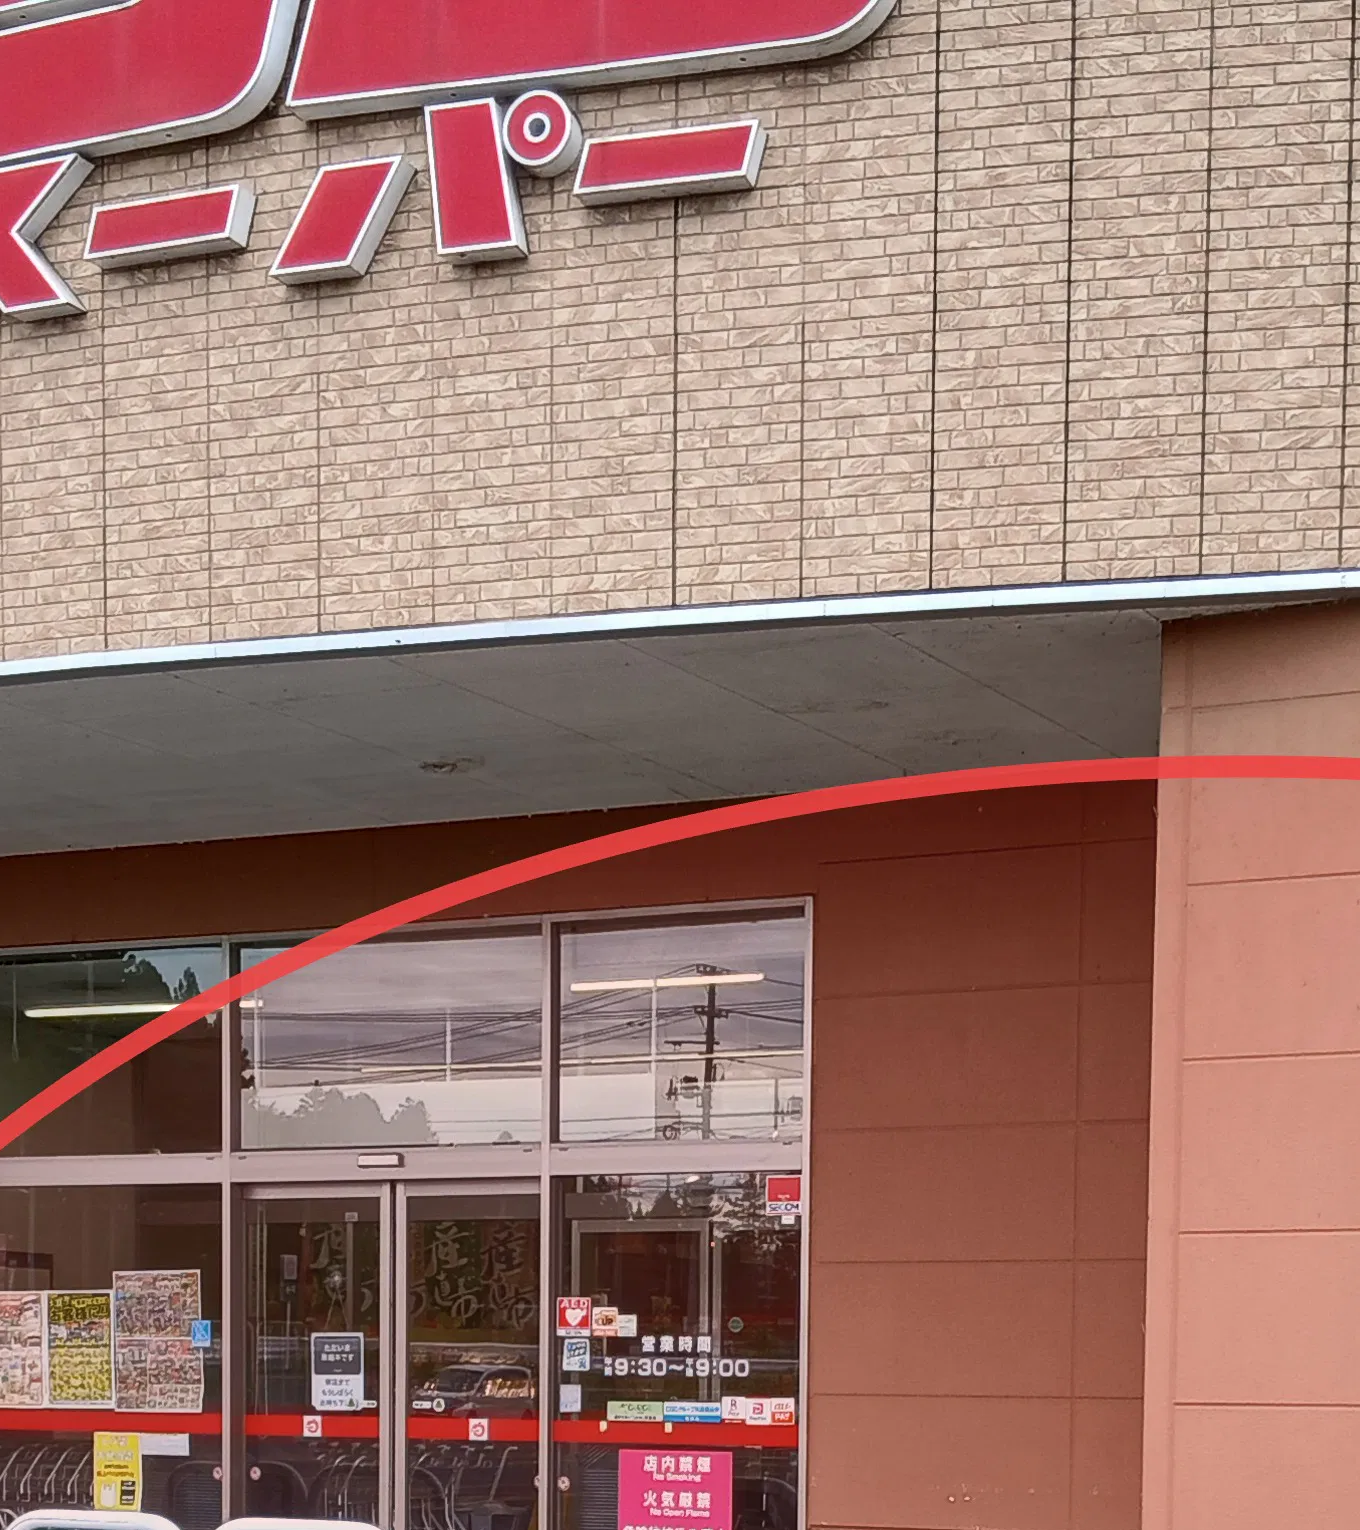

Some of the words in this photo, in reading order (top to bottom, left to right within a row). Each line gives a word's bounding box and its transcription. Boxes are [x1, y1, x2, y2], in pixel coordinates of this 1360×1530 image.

[560, 1299, 588, 1308] AED
[641, 1335, 712, 1354] 営業時間
[644, 1455, 711, 1473] 店内禁煙
[666, 1473, 702, 1482] Smoking
[643, 1490, 711, 1509] 火気厳禁
[650, 1508, 662, 1516] No
[663, 1509, 685, 1517] Open
